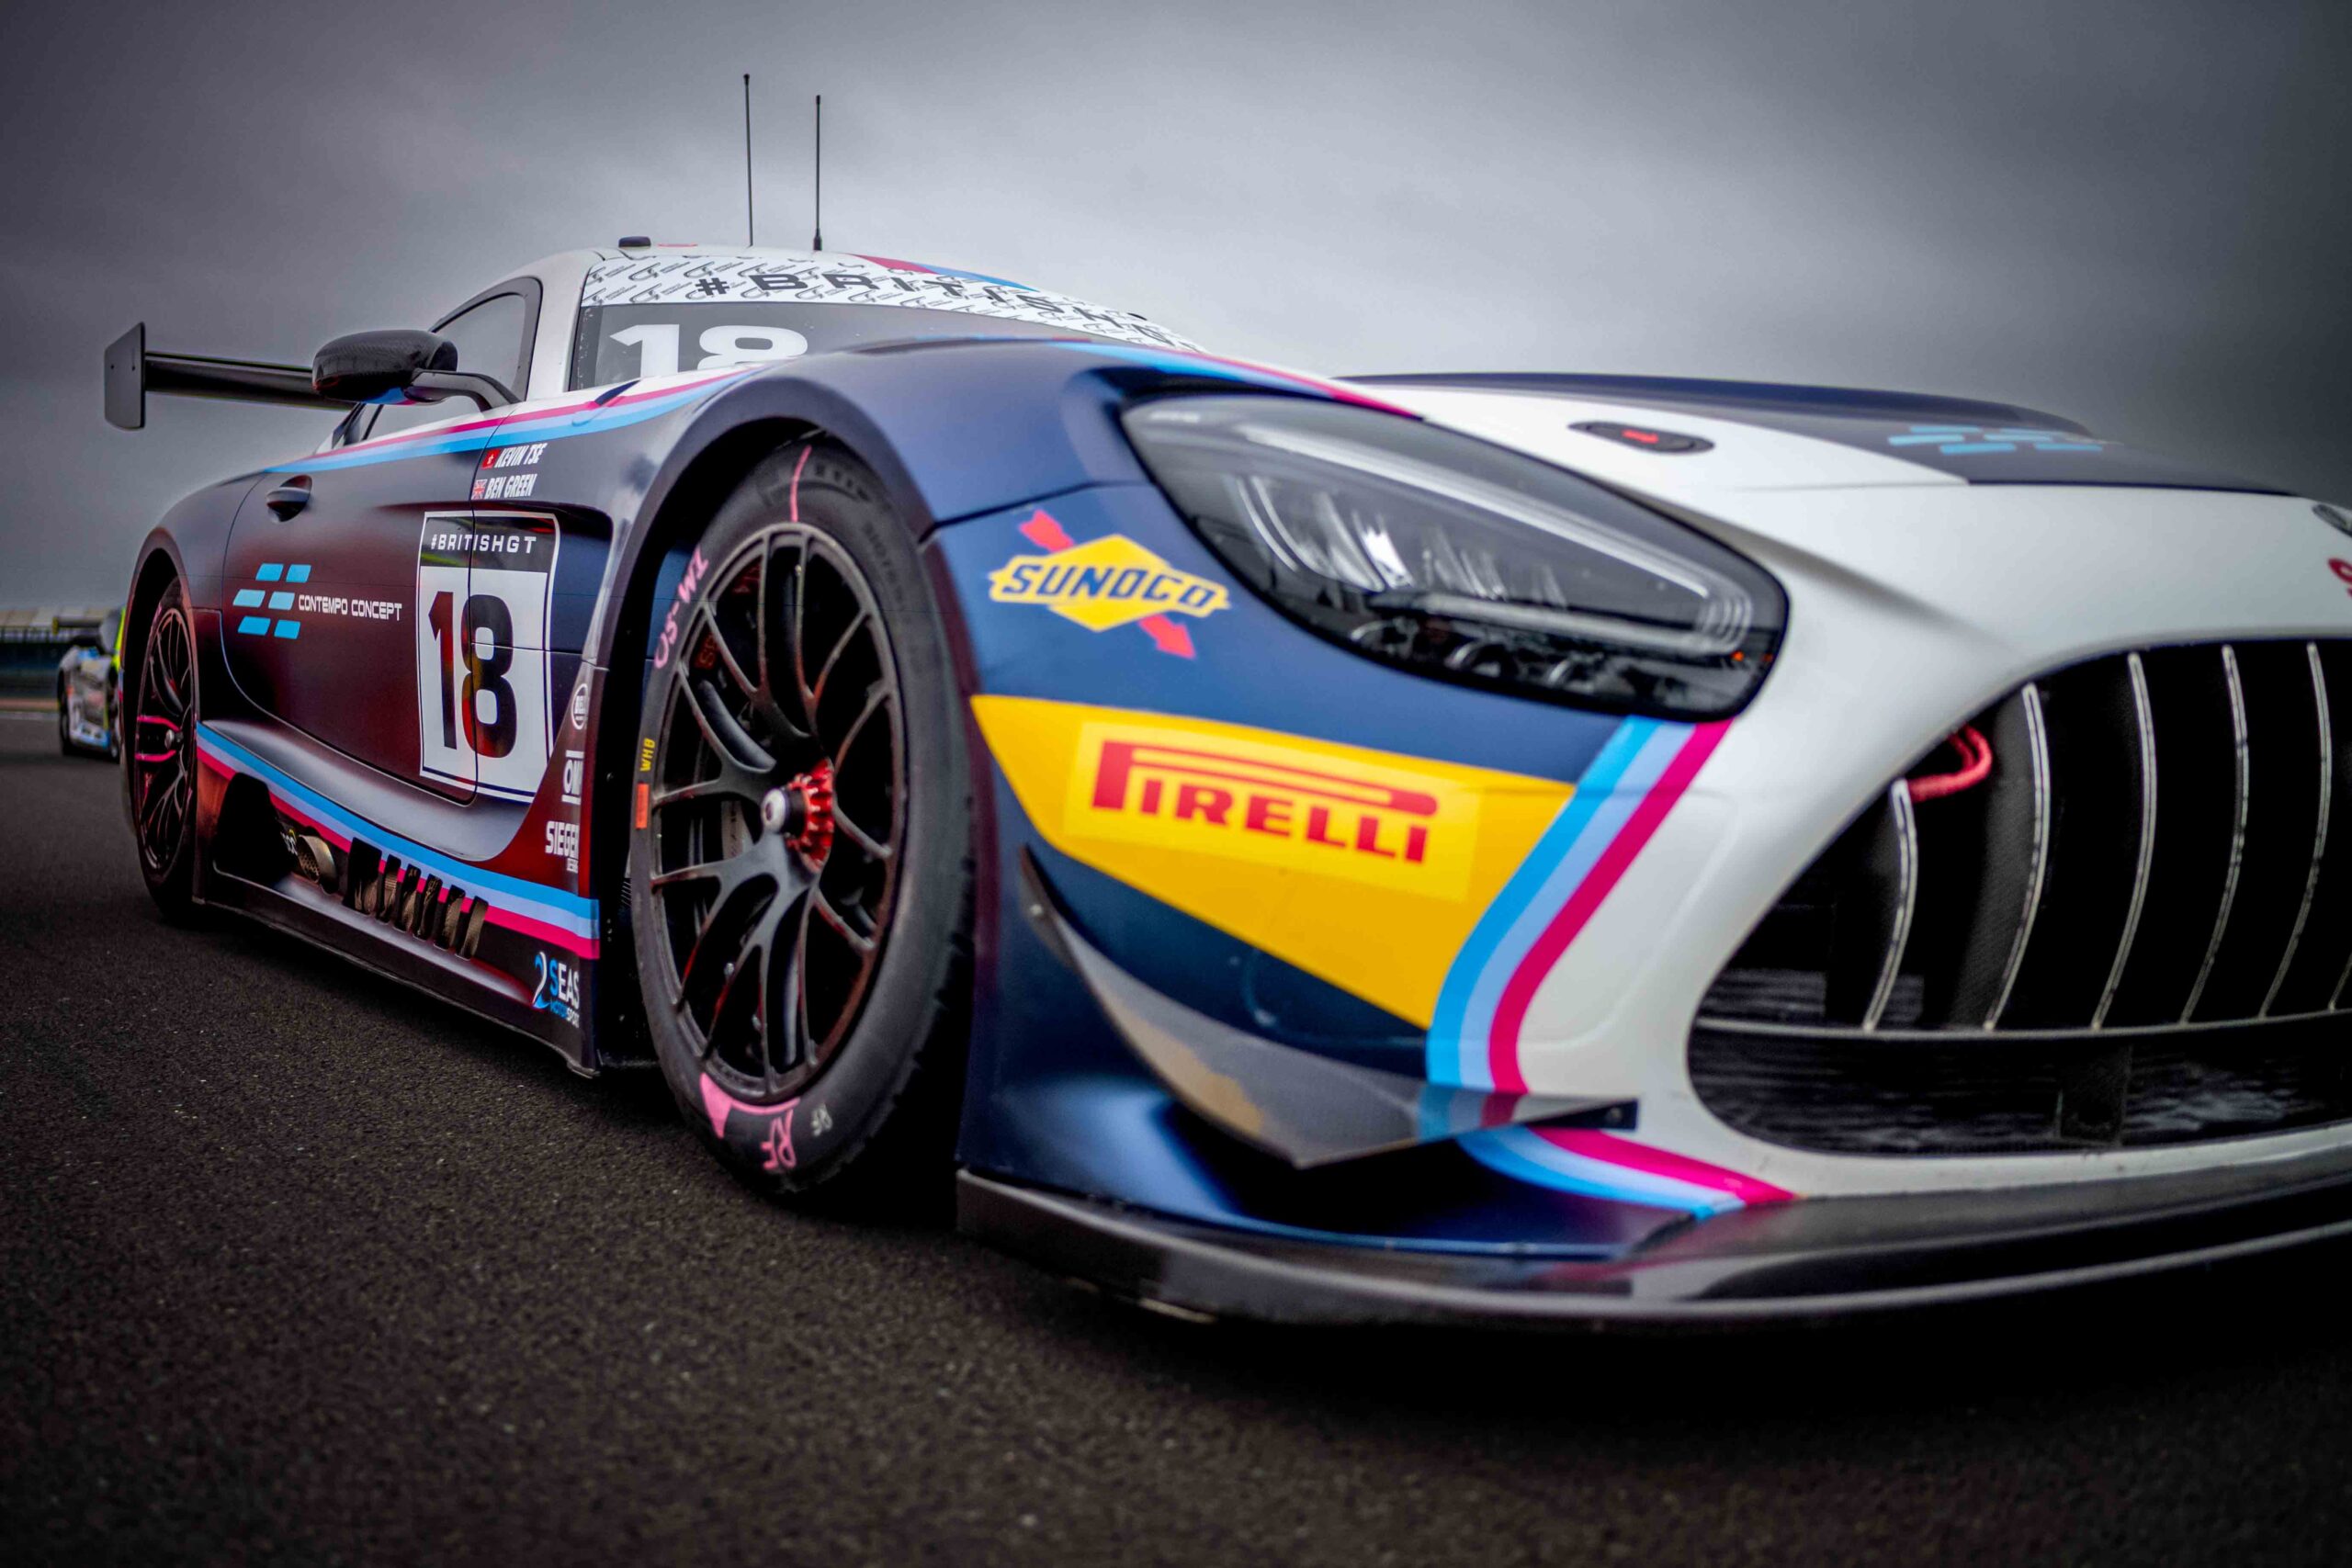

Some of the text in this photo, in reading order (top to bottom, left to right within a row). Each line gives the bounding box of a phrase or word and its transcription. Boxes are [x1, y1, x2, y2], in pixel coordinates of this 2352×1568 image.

[609, 323, 808, 378] 18
[494, 442, 548, 468] KEVIN TSE
[484, 473, 537, 499] BEN GREEN
[431, 534, 537, 553] #BRITISHGT
[299, 594, 402, 621] CONTEMPO CONCEPT
[1002, 563, 1216, 609] SUNOCO
[428, 591, 517, 759] 18
[1091, 739, 1439, 864] PIRELLI
[549, 958, 580, 1010] SEAS
